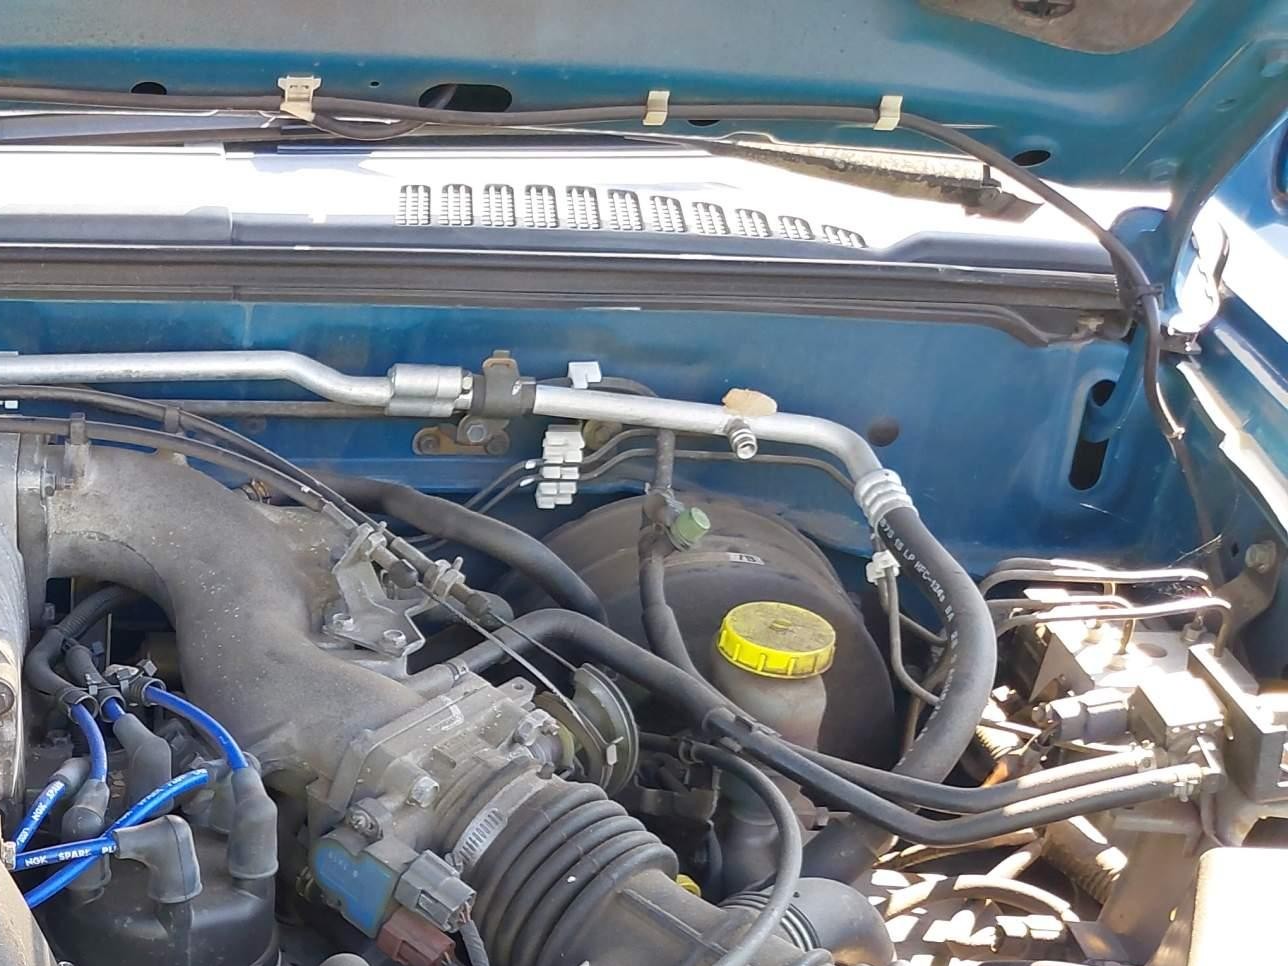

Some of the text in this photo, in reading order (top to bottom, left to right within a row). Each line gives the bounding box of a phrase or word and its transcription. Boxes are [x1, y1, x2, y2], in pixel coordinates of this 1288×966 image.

[903, 549, 915, 560] LP
[31, 802, 48, 823] NGK
[24, 854, 49, 867] NGK
[58, 848, 92, 862] SPARK
